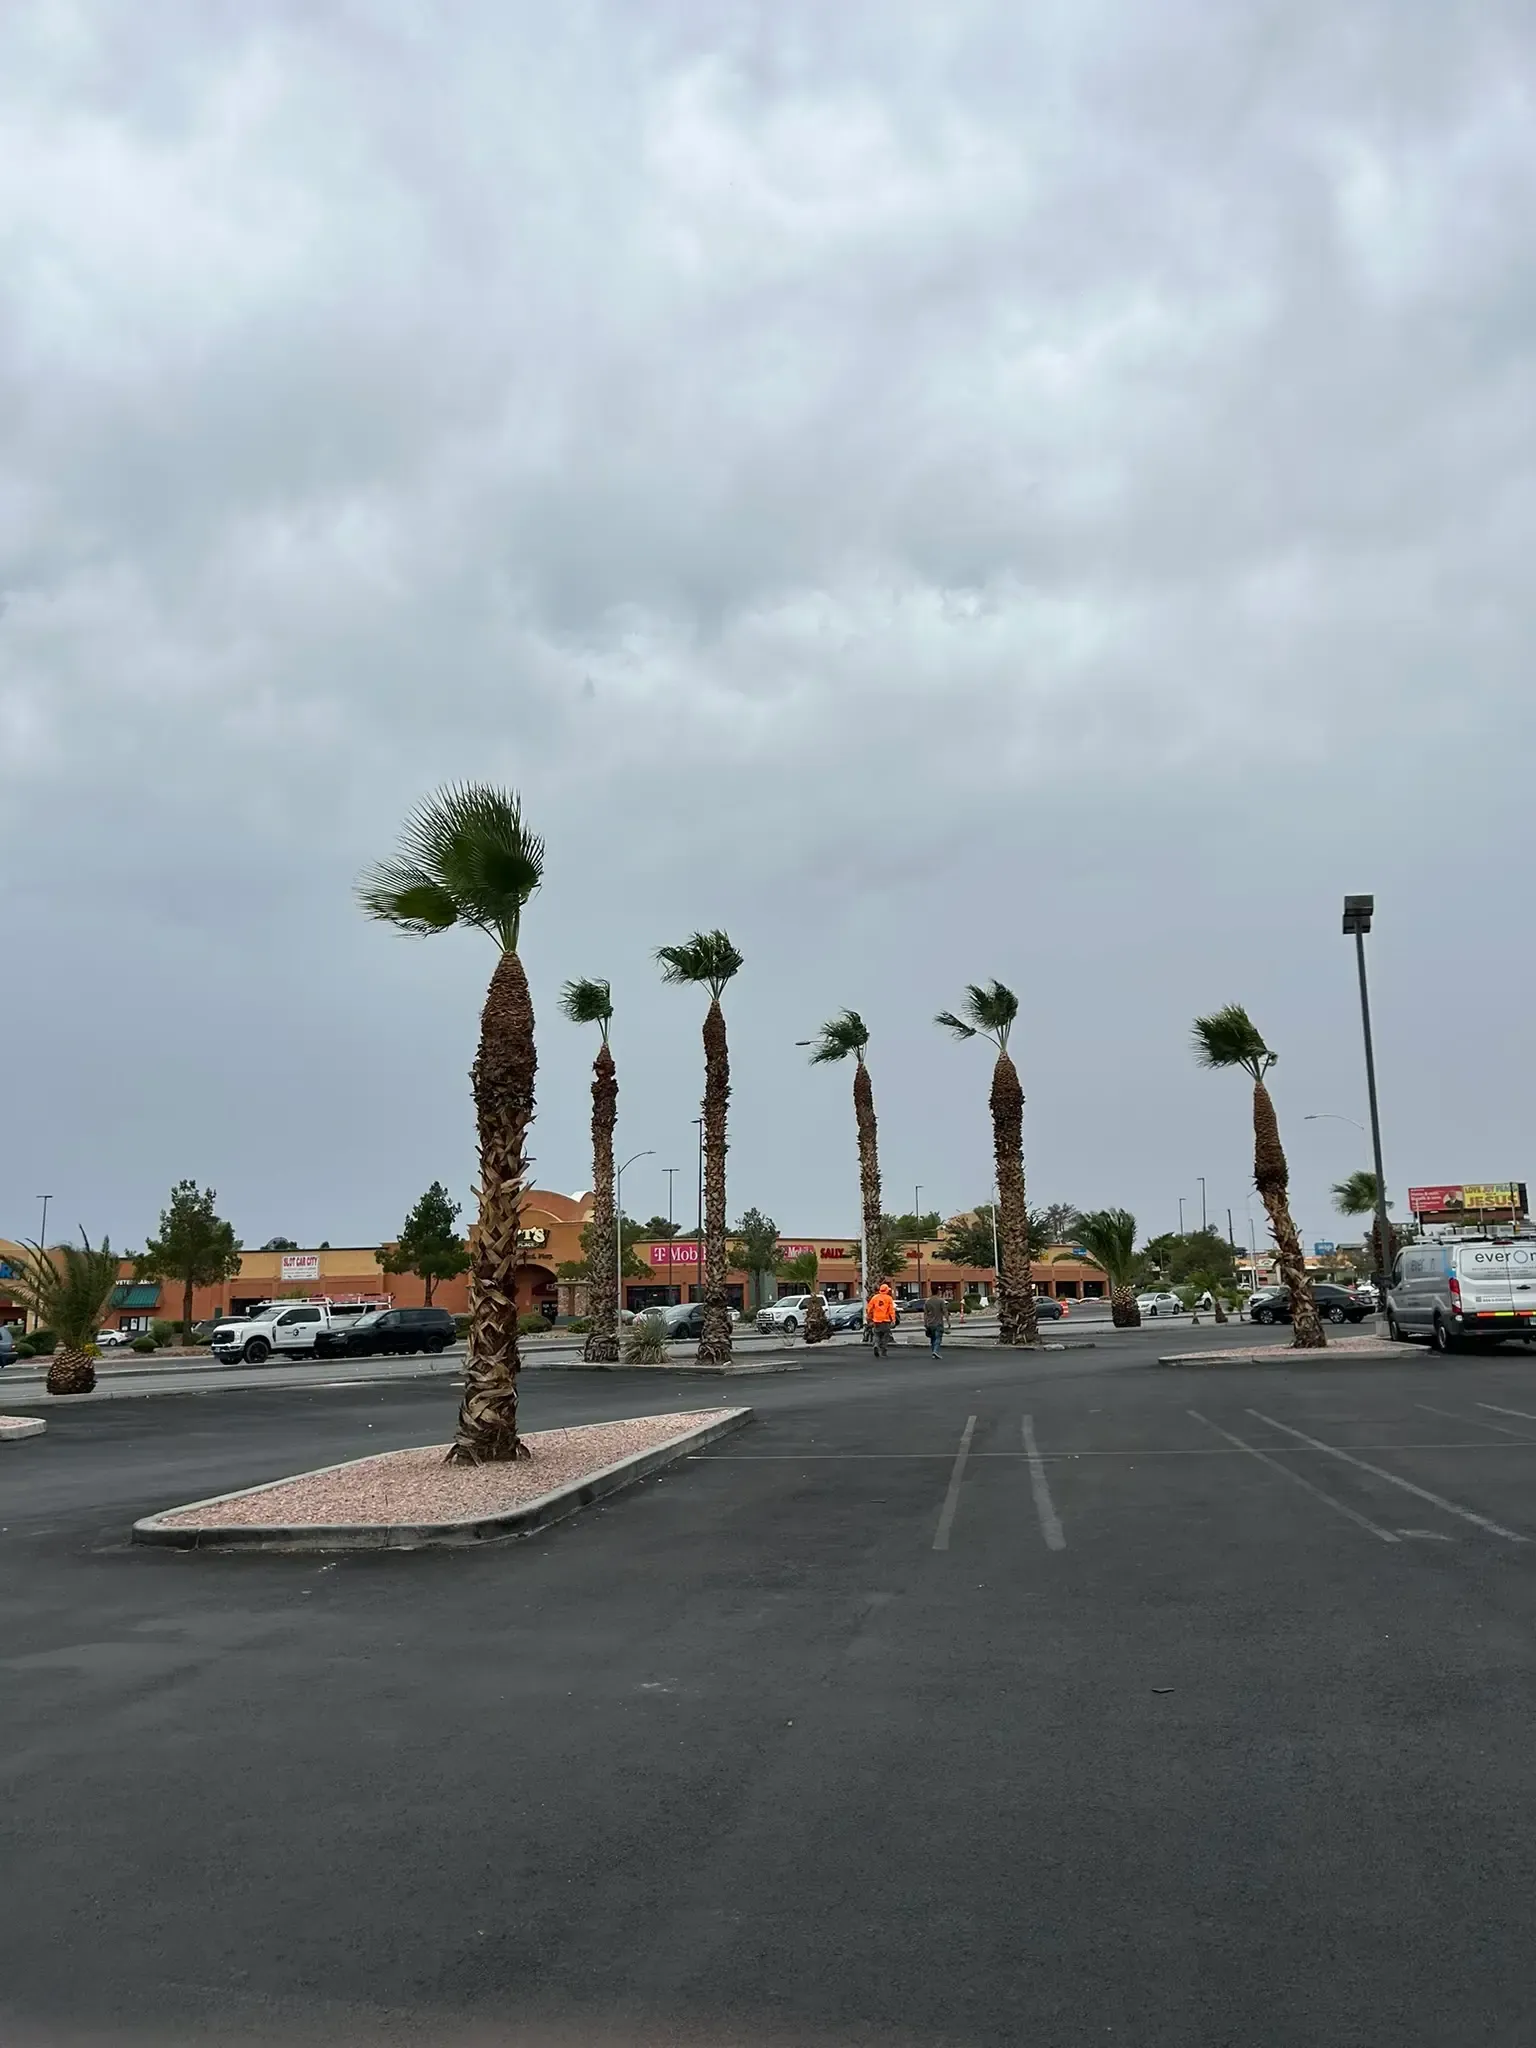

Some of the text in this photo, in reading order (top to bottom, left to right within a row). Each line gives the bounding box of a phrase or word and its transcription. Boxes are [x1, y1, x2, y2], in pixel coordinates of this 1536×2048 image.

[1496, 1183, 1519, 1193] PEAE
[1467, 1195, 1518, 1207] JESUS
[517, 1227, 545, 1242] T'S
[669, 1246, 706, 1261] Mobl
[820, 1248, 844, 1258] SALLY
[283, 1256, 317, 1266] SLOT CAR CITY
